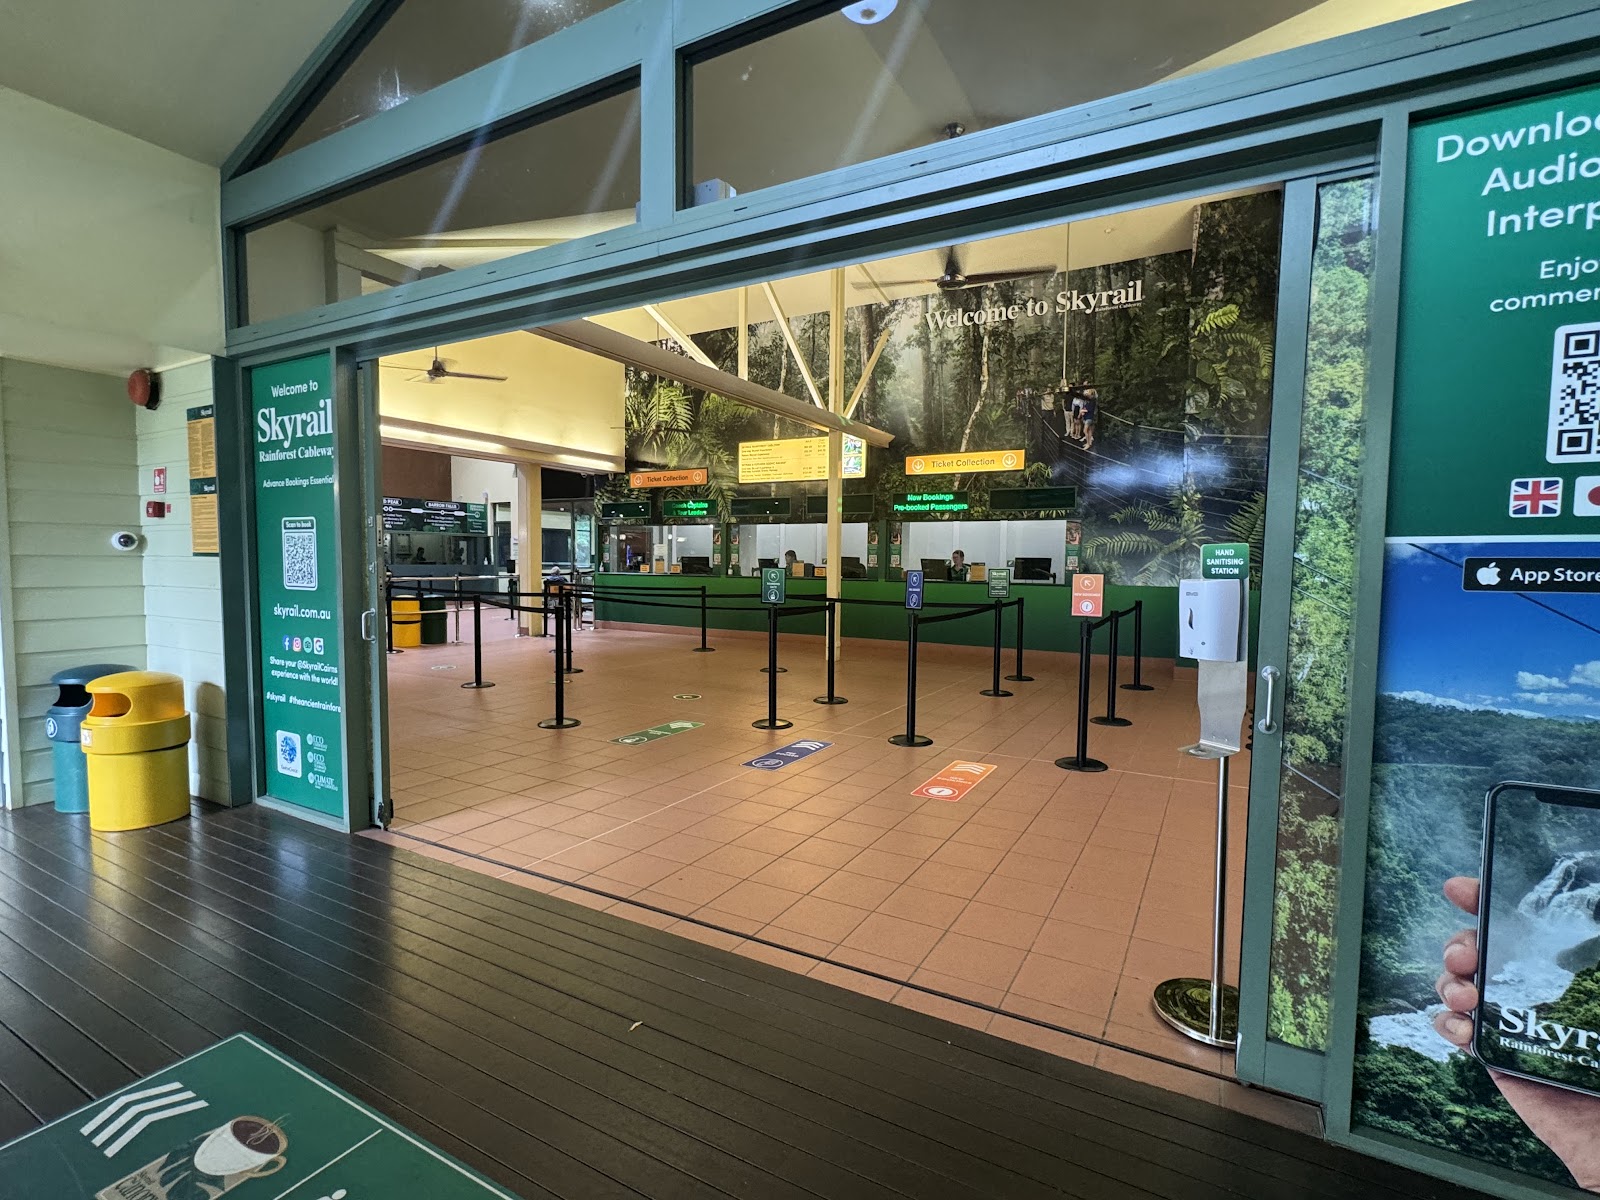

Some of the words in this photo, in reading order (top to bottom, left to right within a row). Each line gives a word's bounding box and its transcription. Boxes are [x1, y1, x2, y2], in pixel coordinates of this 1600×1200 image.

[1437, 111, 1600, 162] Downlo
[1481, 152, 1600, 196] Audio
[1540, 256, 1600, 281] Enjo
[925, 305, 1019, 332] Welcome
[1026, 298, 1048, 317] to
[1056, 280, 1142, 314] Skyrail
[271, 384, 307, 397] Welcome
[309, 380, 318, 391] to
[258, 399, 333, 448] Skyrail
[259, 449, 296, 462] Rainforest
[956, 458, 995, 467] Collection
[263, 480, 284, 488] Advance
[285, 477, 309, 487] Bookings
[923, 493, 953, 501] Bookings
[930, 503, 968, 511] Passengers
[1206, 558, 1244, 566] SANITISING
[1211, 567, 1239, 575] STATION
[1510, 568, 1550, 584] App
[273, 603, 331, 619] skyrail.com.au
[270, 656, 284, 666] Share
[285, 660, 296, 668] your
[271, 670, 298, 678] experience
[299, 672, 310, 681] with
[311, 674, 320, 683] the
[267, 691, 286, 702] #skyrail
[1499, 1006, 1600, 1052] Skyr
[1500, 1036, 1573, 1062] Rainforest
[1577, 1055, 1600, 1069] Ca
